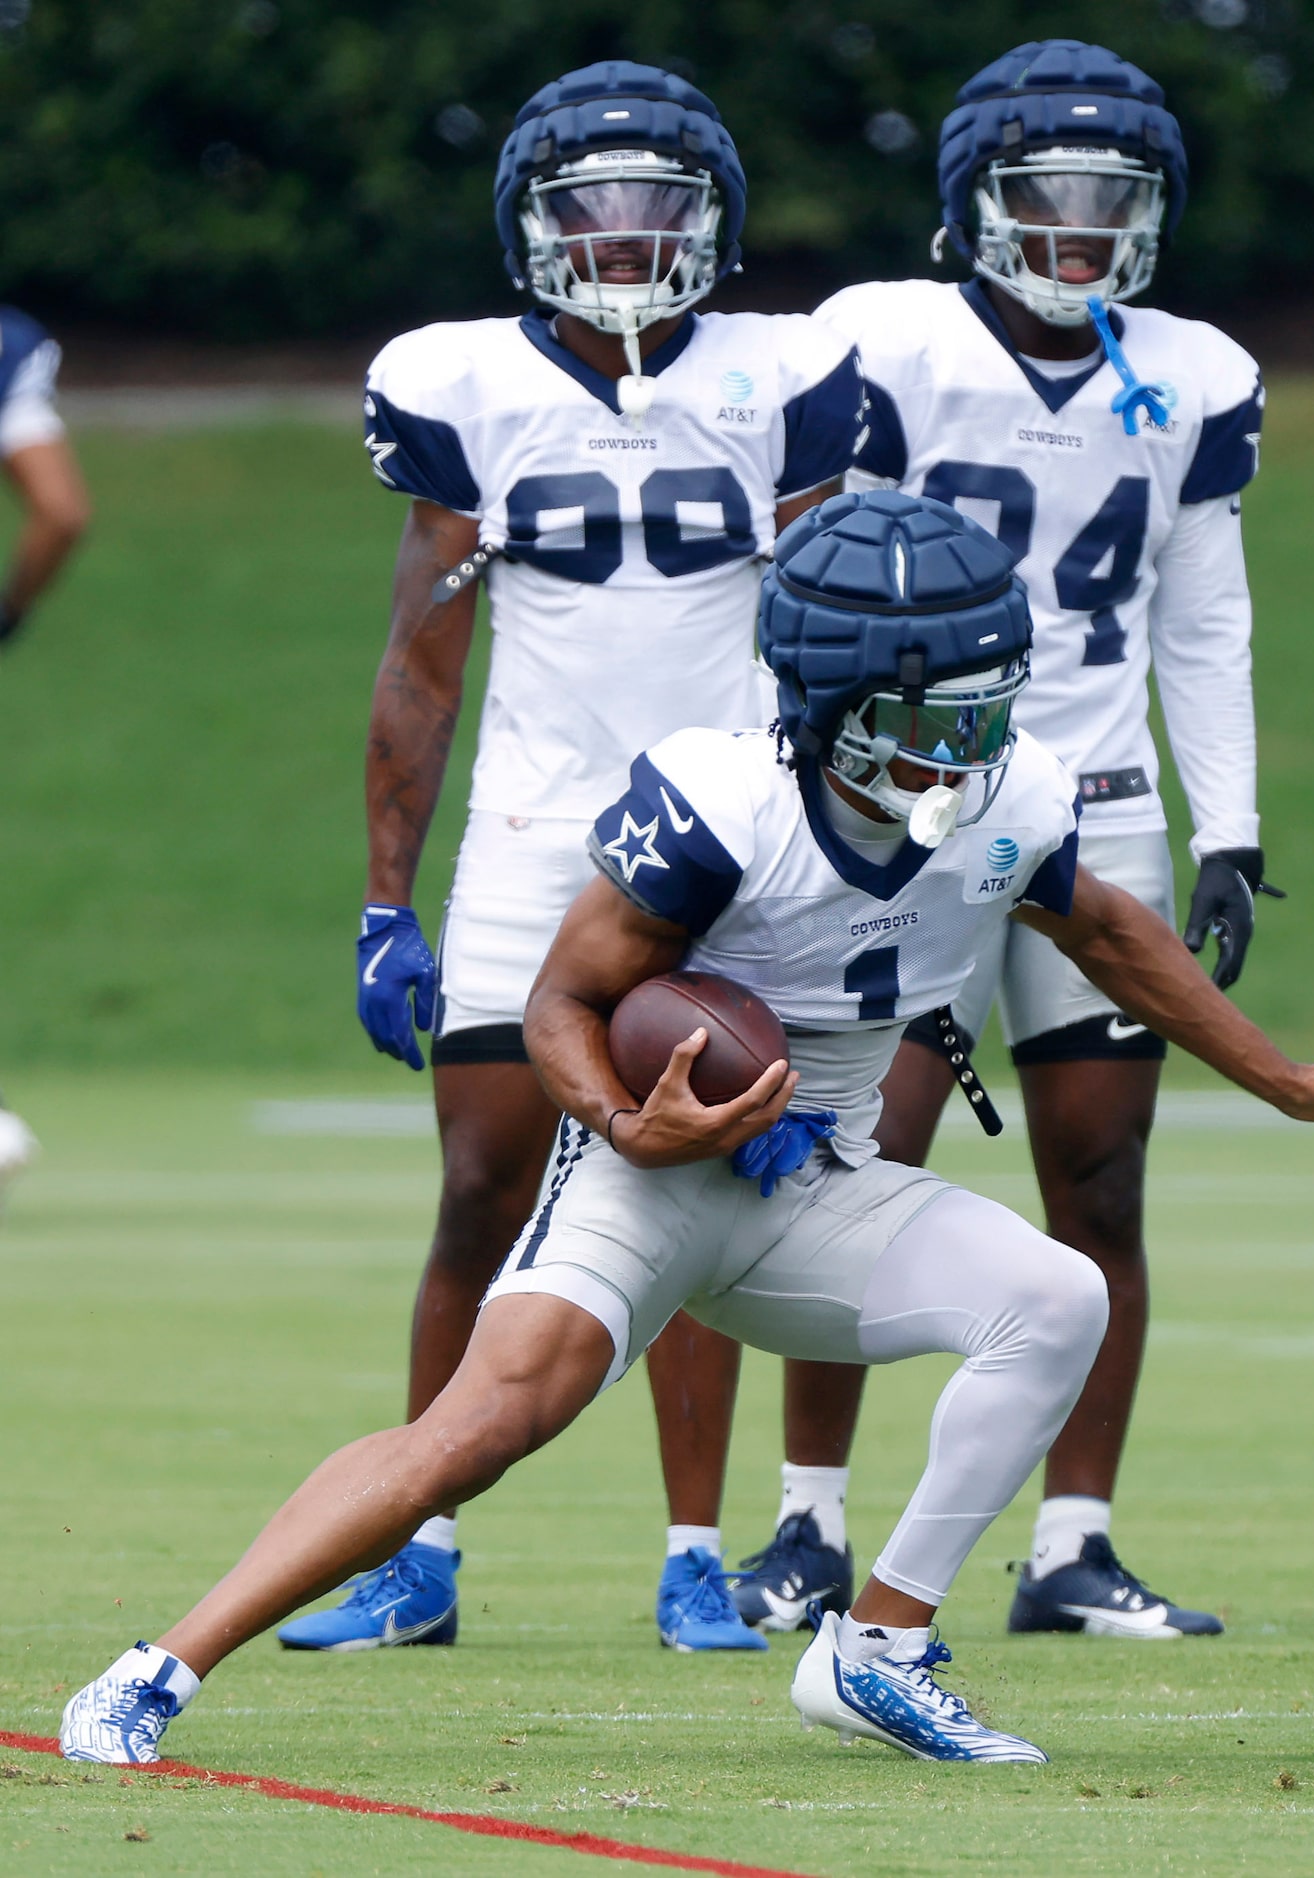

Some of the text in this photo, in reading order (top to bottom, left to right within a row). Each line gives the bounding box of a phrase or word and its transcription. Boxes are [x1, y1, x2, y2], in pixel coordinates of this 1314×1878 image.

[717, 407, 758, 423] AT&T
[588, 439, 658, 450] COWBOYS
[1018, 429, 1084, 448] COWBOYS
[978, 874, 1015, 894] AT&T
[851, 911, 919, 937] COWBOYS
[843, 945, 900, 1021] 1
